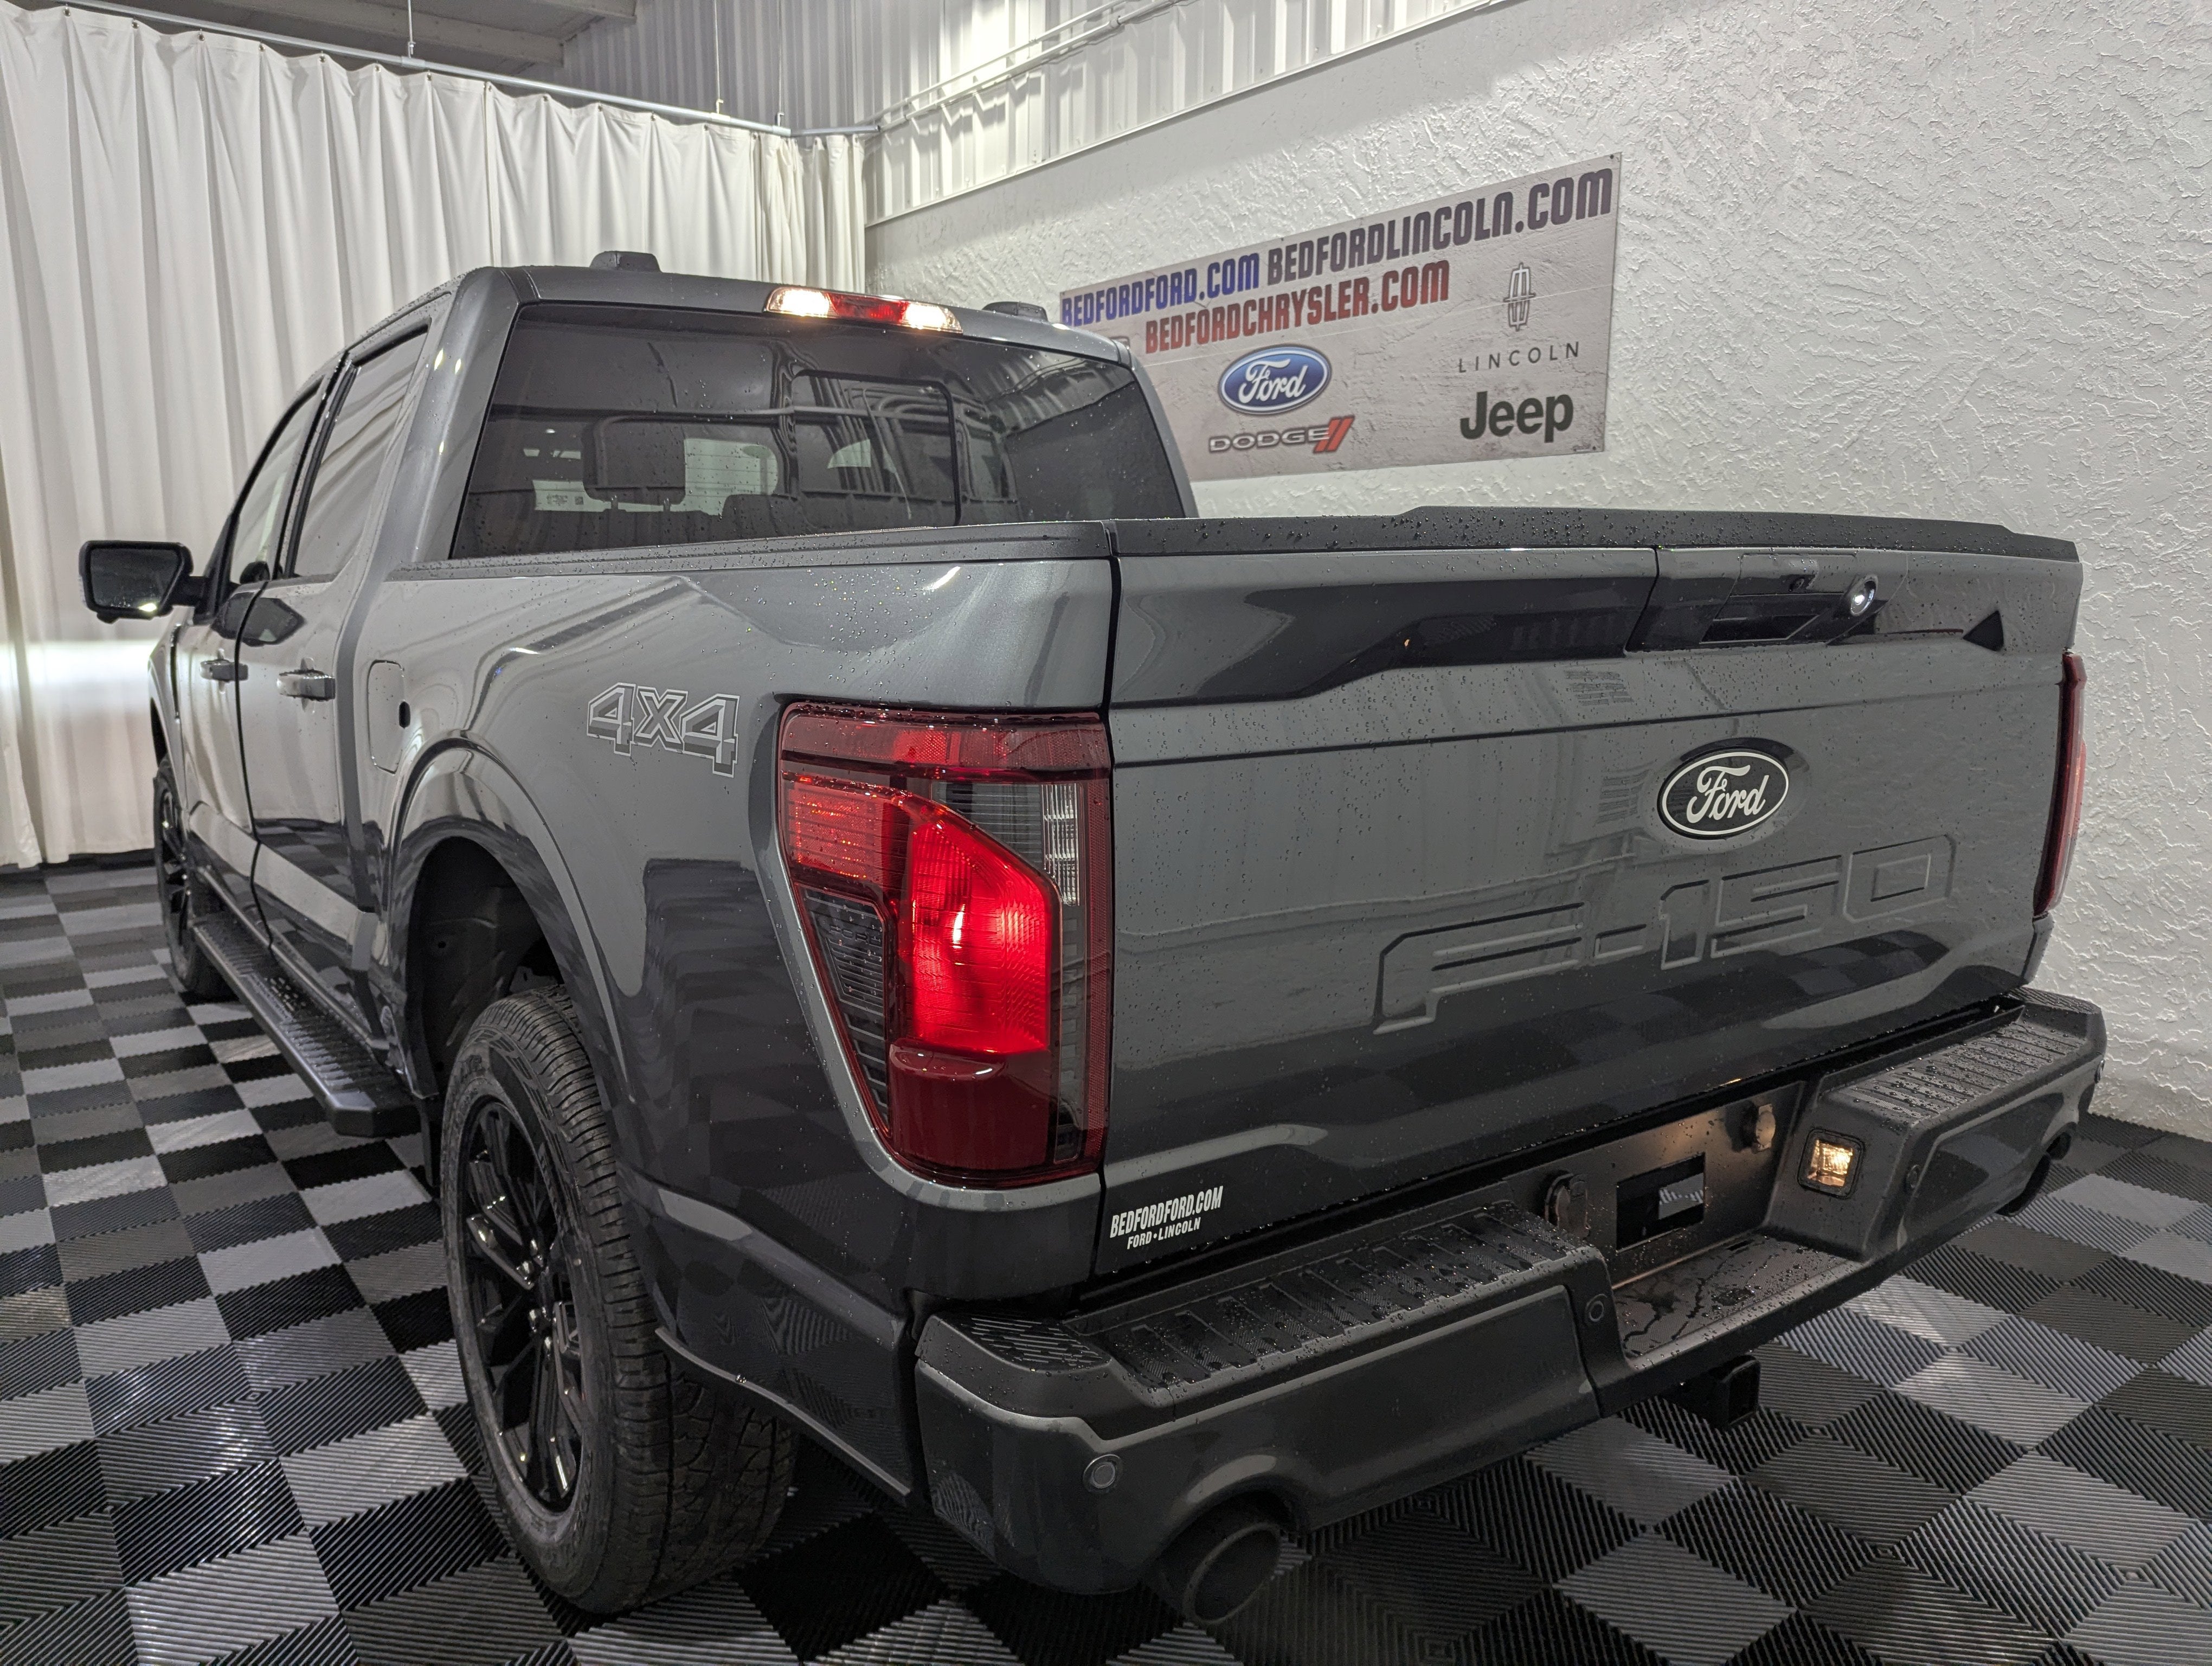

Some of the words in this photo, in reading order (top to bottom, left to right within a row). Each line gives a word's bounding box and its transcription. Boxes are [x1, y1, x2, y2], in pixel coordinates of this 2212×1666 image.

[1061, 253, 1259, 327] BEDFORDFORD.COM
[1268, 169, 1612, 285] BEDFORDLINCOLN.COM
[1146, 260, 1449, 354] BEDFORDCHRYSLER.COM
[1238, 359, 1306, 403] Ford
[1459, 342, 1579, 373] LINCOLN
[1209, 426, 1332, 453] DODGE
[1459, 391, 1573, 443] Jeep
[1686, 765, 1769, 823] Ford
[1373, 835, 1953, 1033] F-150
[1110, 1186, 1224, 1238] BEDFORDFORD.COM
